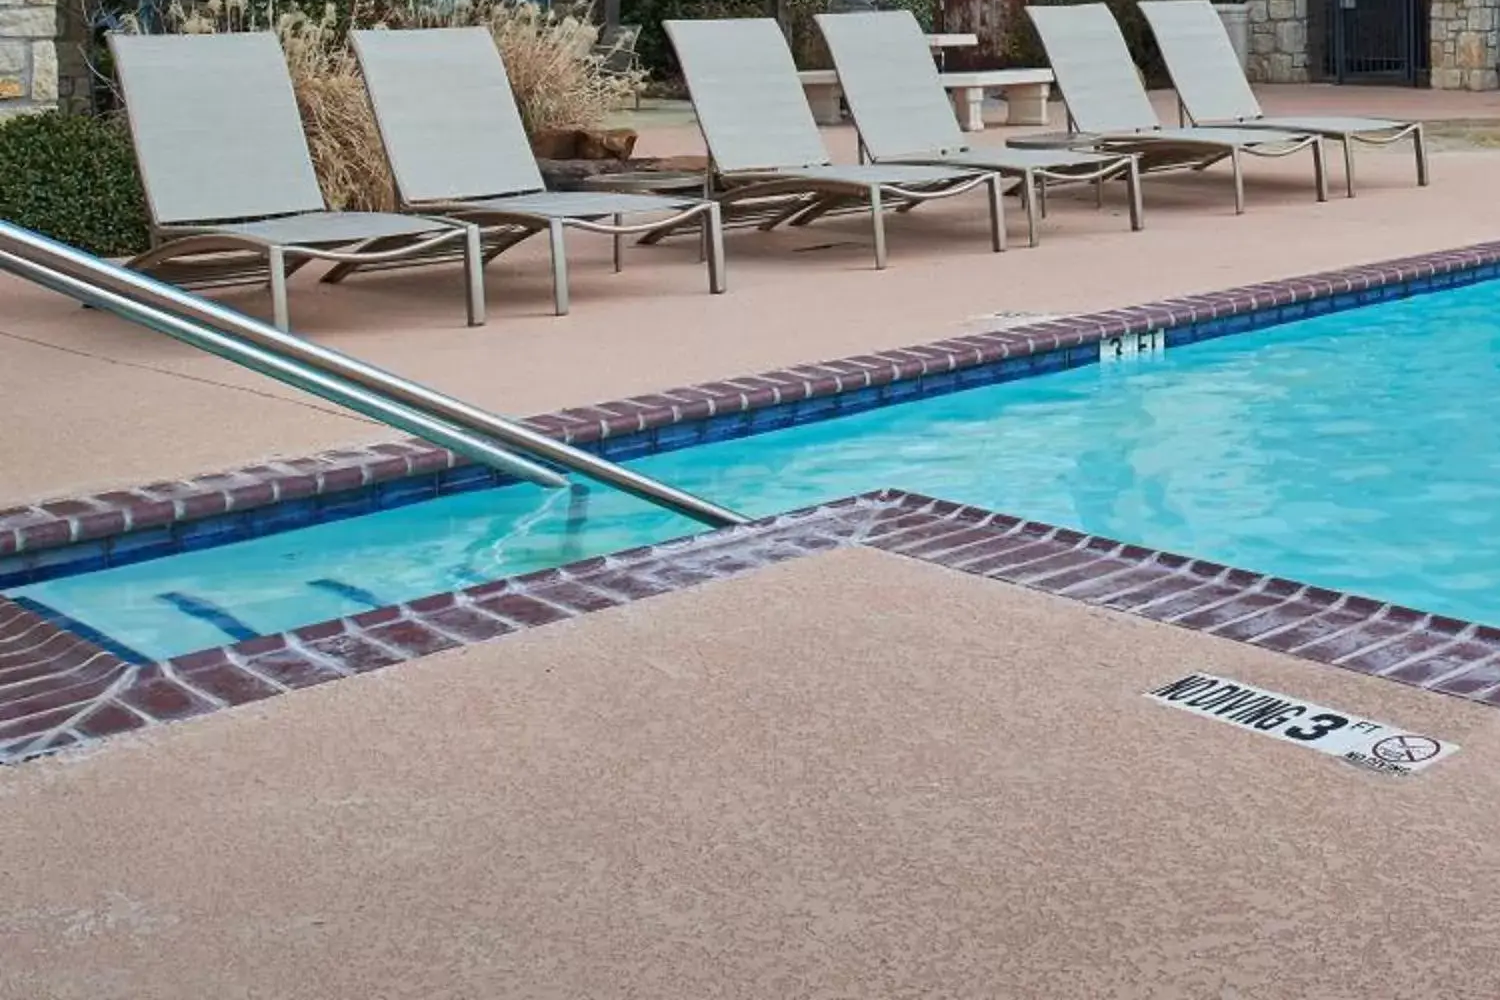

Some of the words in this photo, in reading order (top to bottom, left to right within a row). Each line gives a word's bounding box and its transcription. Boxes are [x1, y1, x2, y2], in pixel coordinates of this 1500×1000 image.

[1150, 674, 1219, 701] NO
[1185, 683, 1307, 731] DIVING
[1284, 713, 1350, 742] 3
[1350, 720, 1383, 735] FT
